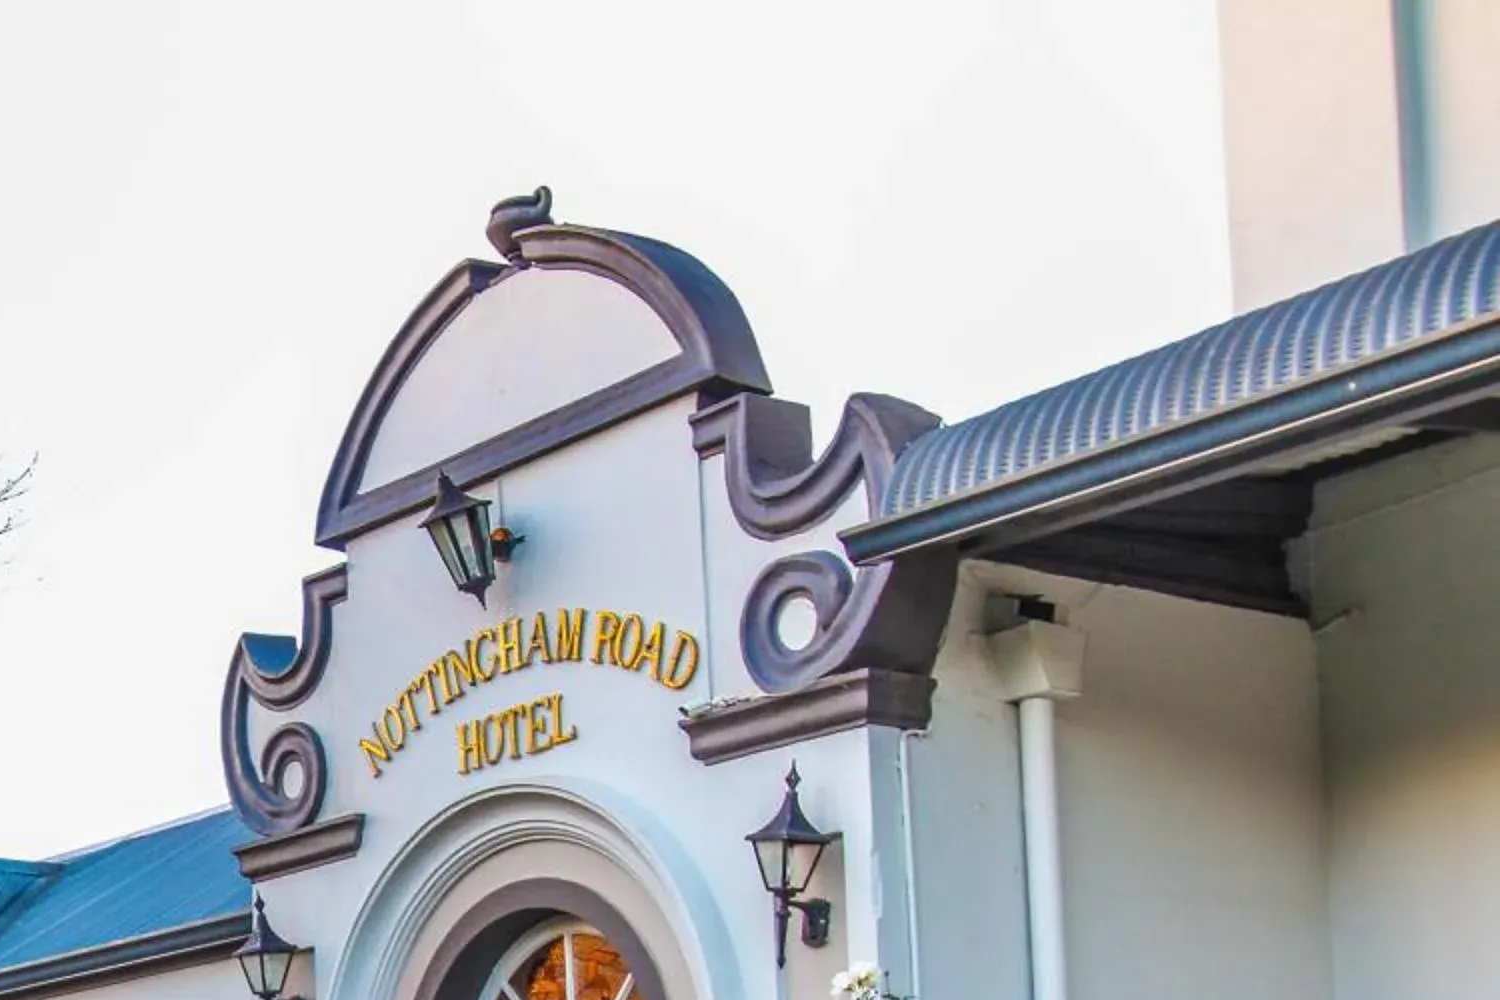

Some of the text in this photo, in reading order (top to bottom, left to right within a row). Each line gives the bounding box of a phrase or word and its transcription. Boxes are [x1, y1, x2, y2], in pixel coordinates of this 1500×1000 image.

[358, 607, 700, 777] NOTTINGHAM ROAD
[455, 690, 579, 776] HOTEL
